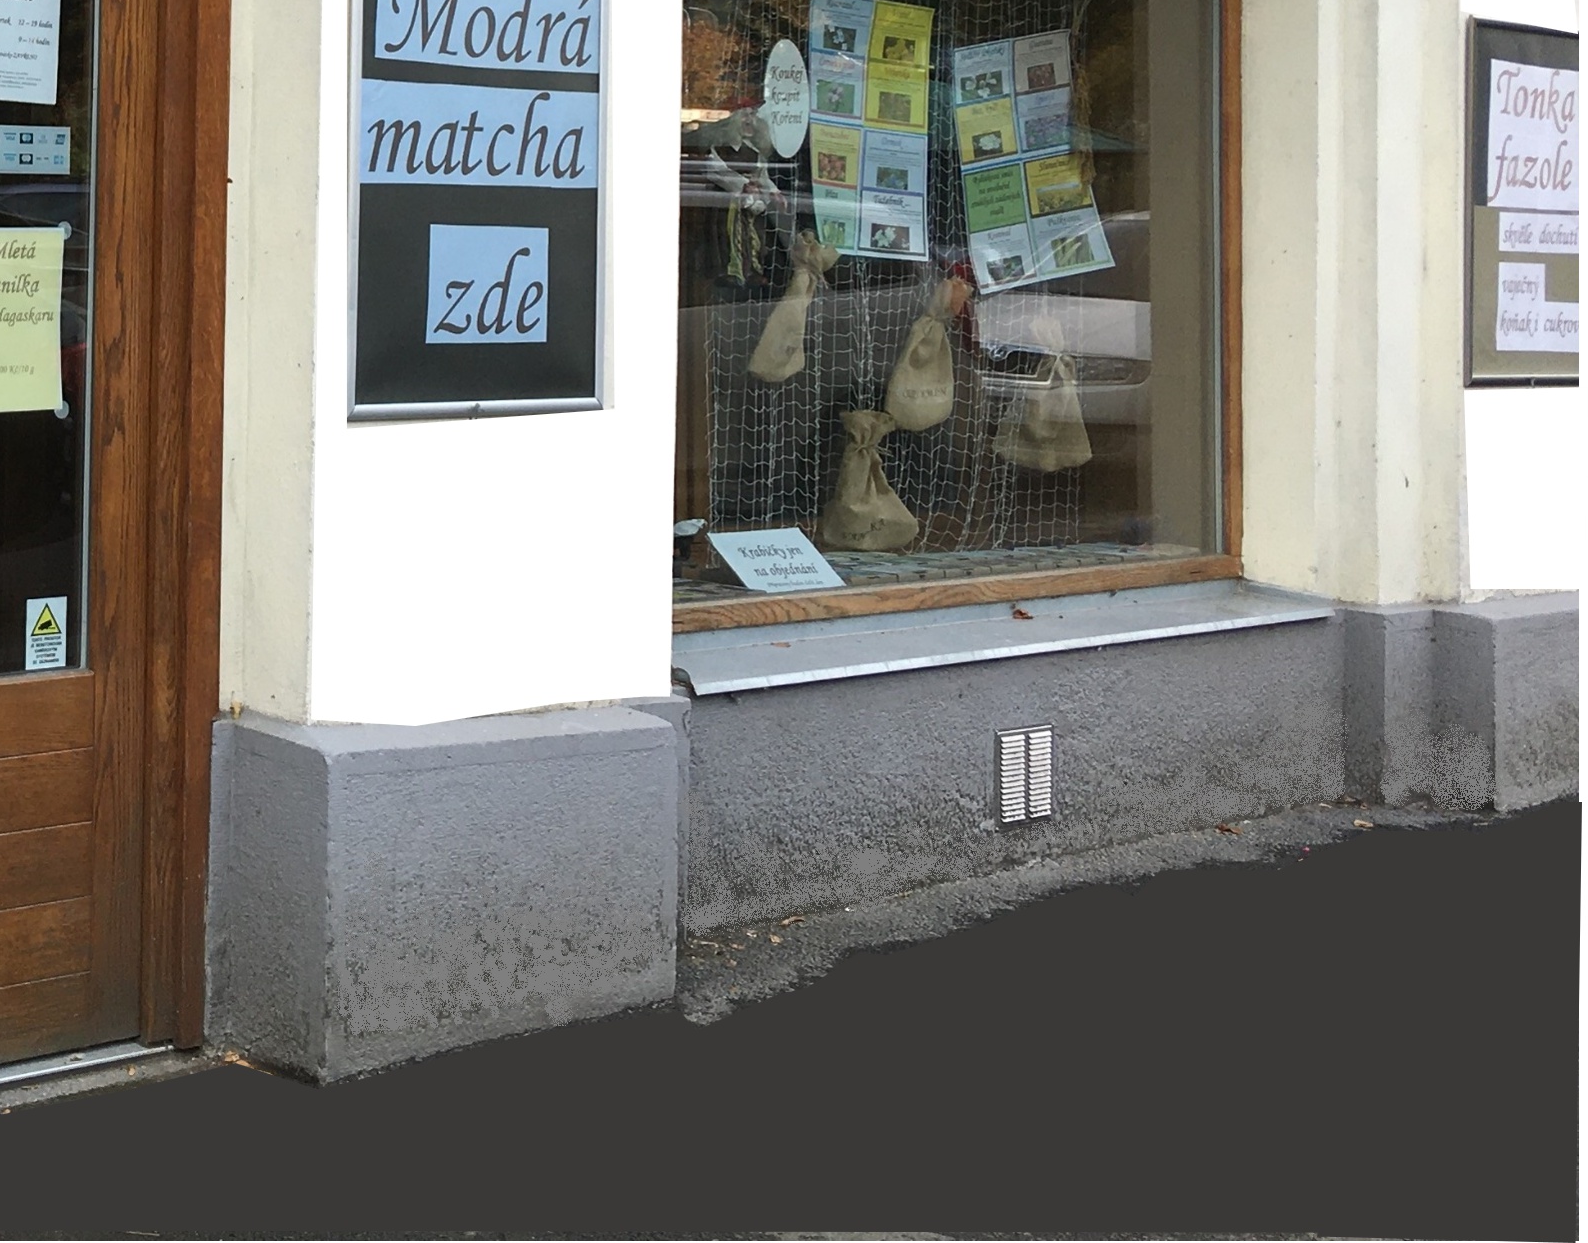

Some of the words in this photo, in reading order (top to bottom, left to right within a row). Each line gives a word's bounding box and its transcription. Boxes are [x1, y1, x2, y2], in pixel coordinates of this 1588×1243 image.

[770, 65, 804, 84] Koukej
[1496, 67, 1576, 134] Tonka
[771, 111, 803, 126] Koření
[367, 90, 585, 181] matcha
[1487, 134, 1573, 203] fazole
[1503, 222, 1533, 249] skvěle
[433, 246, 545, 336] zde
[1499, 310, 1534, 337] koňak
[737, 544, 786, 560] Krabičky
[786, 544, 804, 559] jen
[754, 568, 769, 577] na
[769, 563, 818, 579] objednání
